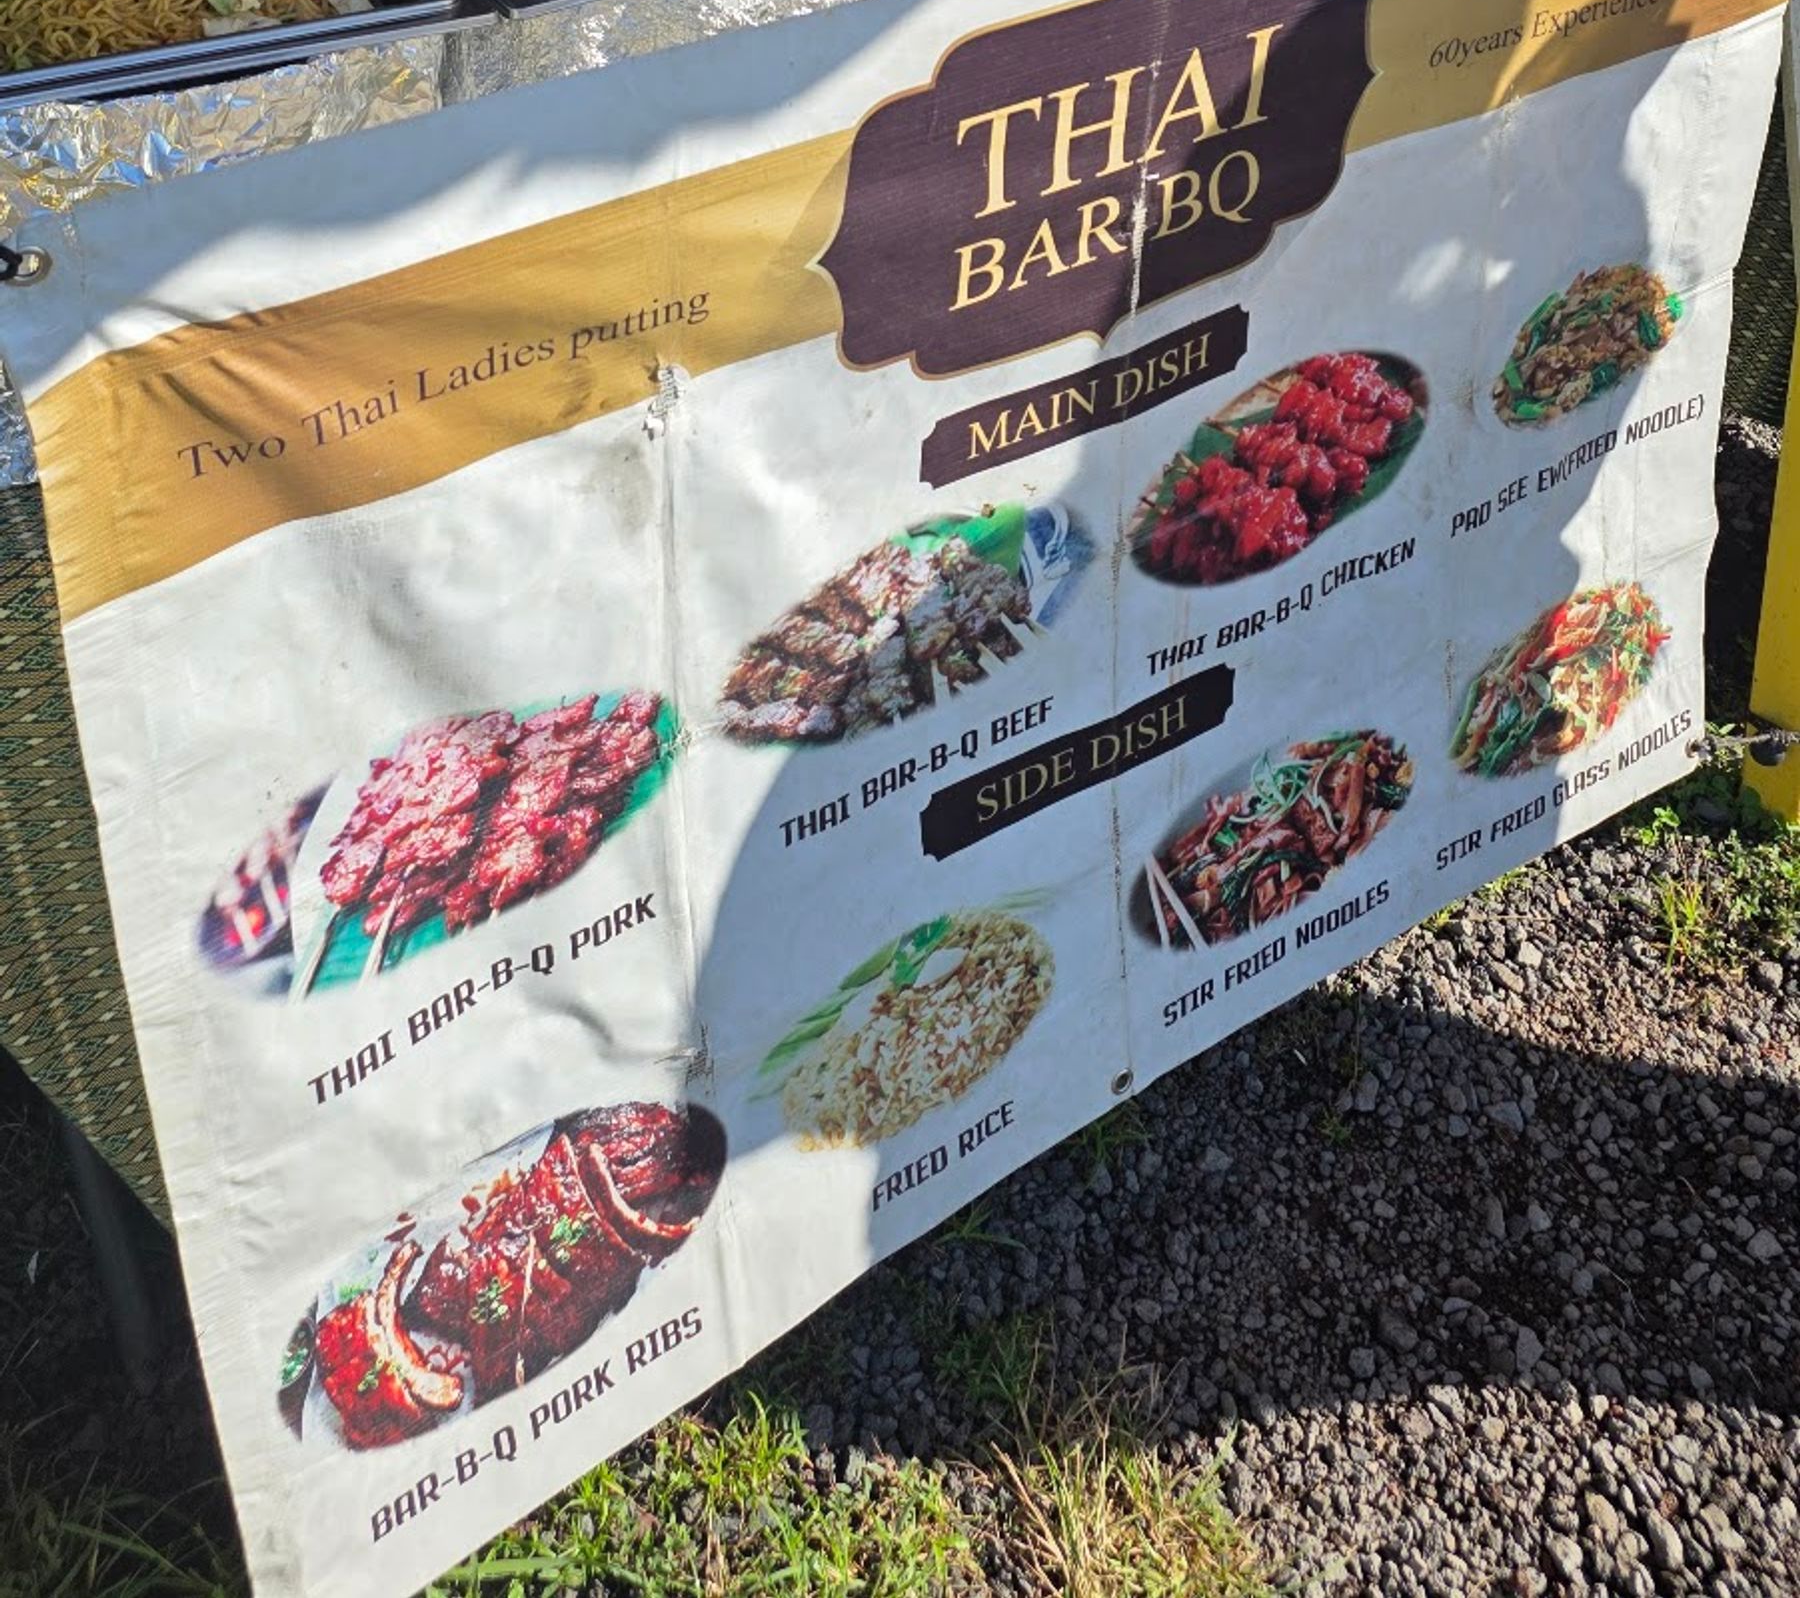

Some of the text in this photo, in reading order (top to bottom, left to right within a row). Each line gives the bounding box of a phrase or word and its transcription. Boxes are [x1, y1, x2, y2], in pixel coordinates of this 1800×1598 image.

[1429, 25, 1524, 68] 60years
[956, 24, 1284, 219] THAI
[177, 291, 711, 479] Two Thai Ladies putting
[966, 331, 1213, 461] MAIN DISH
[1450, 499, 1492, 539] PAD
[1497, 475, 1530, 513] SEE
[1625, 394, 1705, 446] NOODLE)
[1147, 537, 1417, 676] THAI BAR-B-Q CHICKEN
[779, 695, 1055, 848] THAI BAR-B-Q BEEF
[976, 695, 1189, 823] SIDE DISH
[1436, 708, 1693, 872] STIR FRIED GLASS NOODLES
[307, 892, 658, 1105] THAI BAR-B-Q PORK
[1163, 879, 1391, 1028] STIR FRIED NOODLES
[872, 1100, 1016, 1213] FRIED RICE
[370, 1306, 704, 1544] BAR-B-Q PORK RIBS
